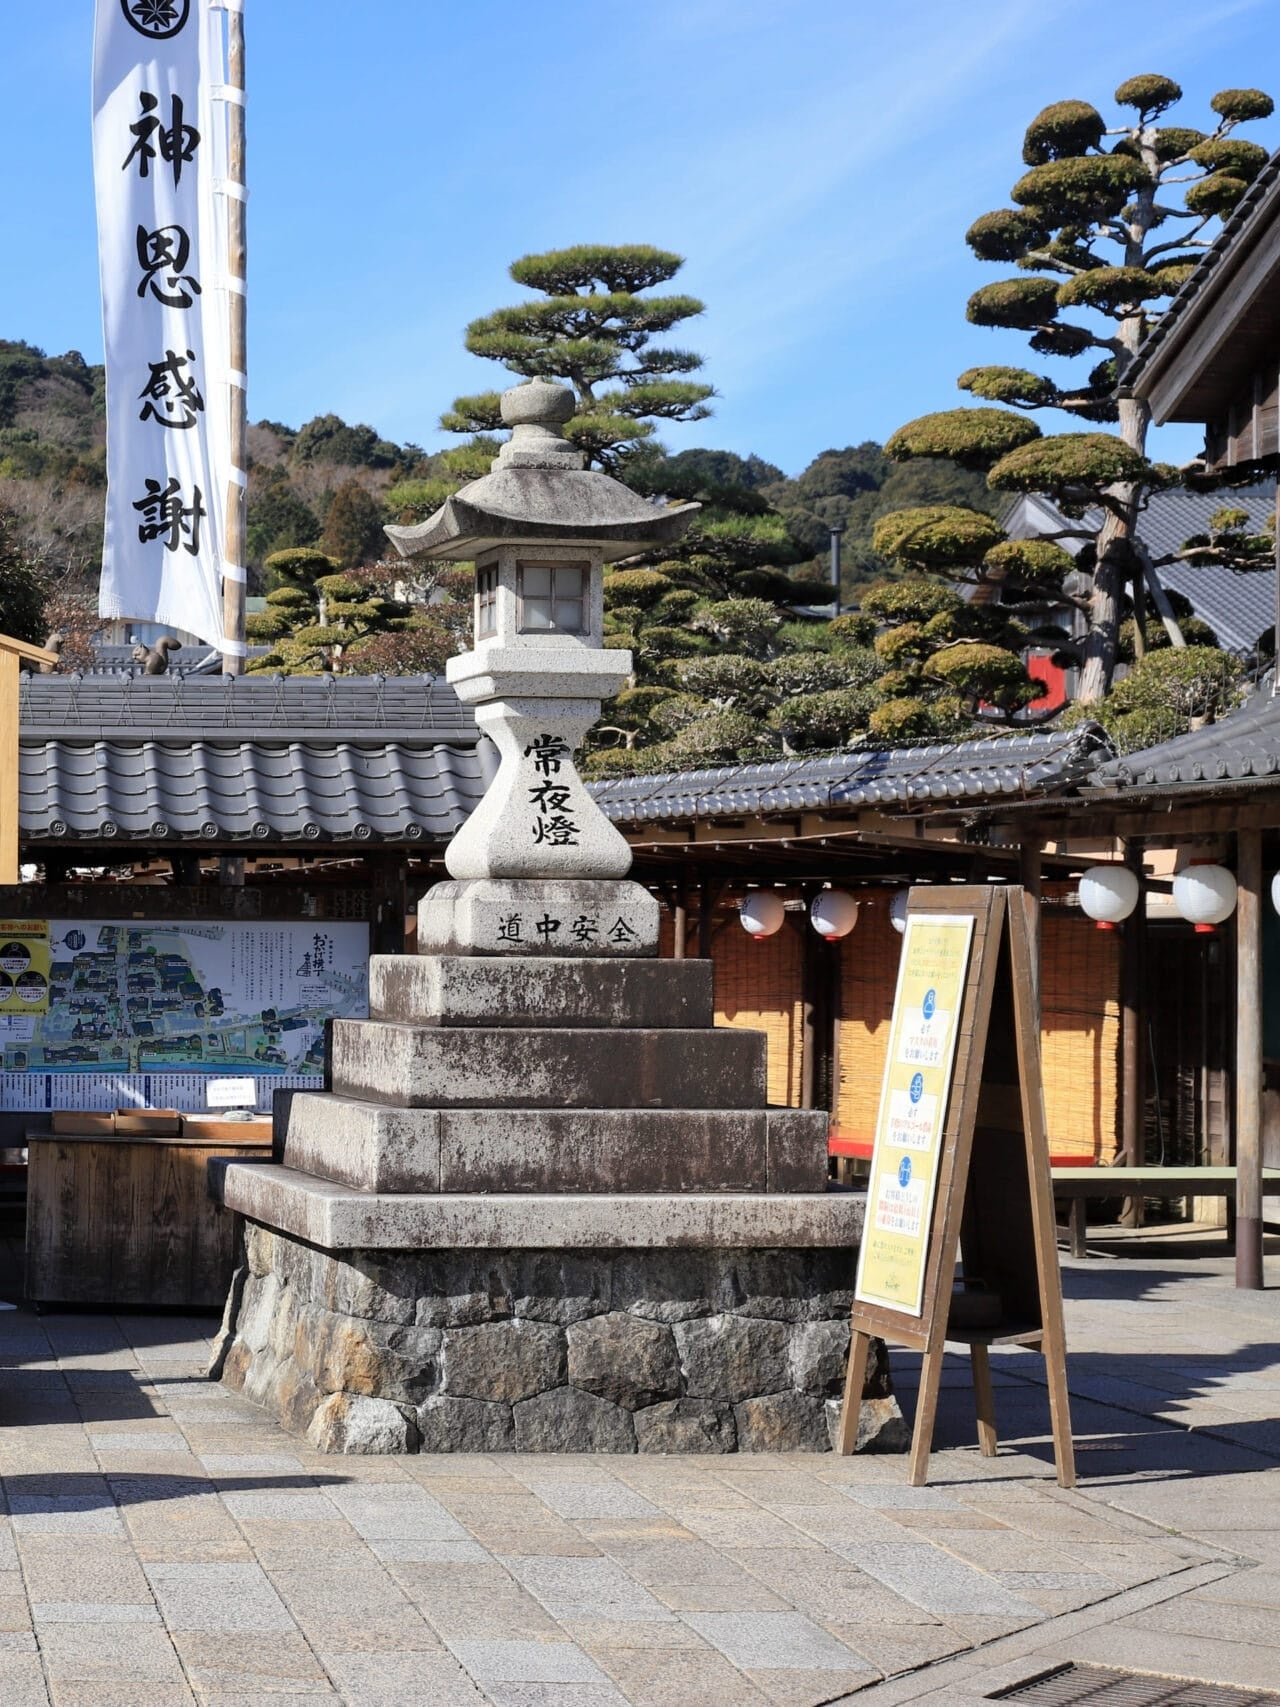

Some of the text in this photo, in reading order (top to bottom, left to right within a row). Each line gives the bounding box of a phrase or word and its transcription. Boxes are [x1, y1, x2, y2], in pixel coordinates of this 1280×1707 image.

[122, 91, 206, 557] 神恩感謝
[524, 734, 581, 846] 常夜燈
[313, 933, 327, 977] おかげ横丁
[497, 913, 637, 943] 道中安全
